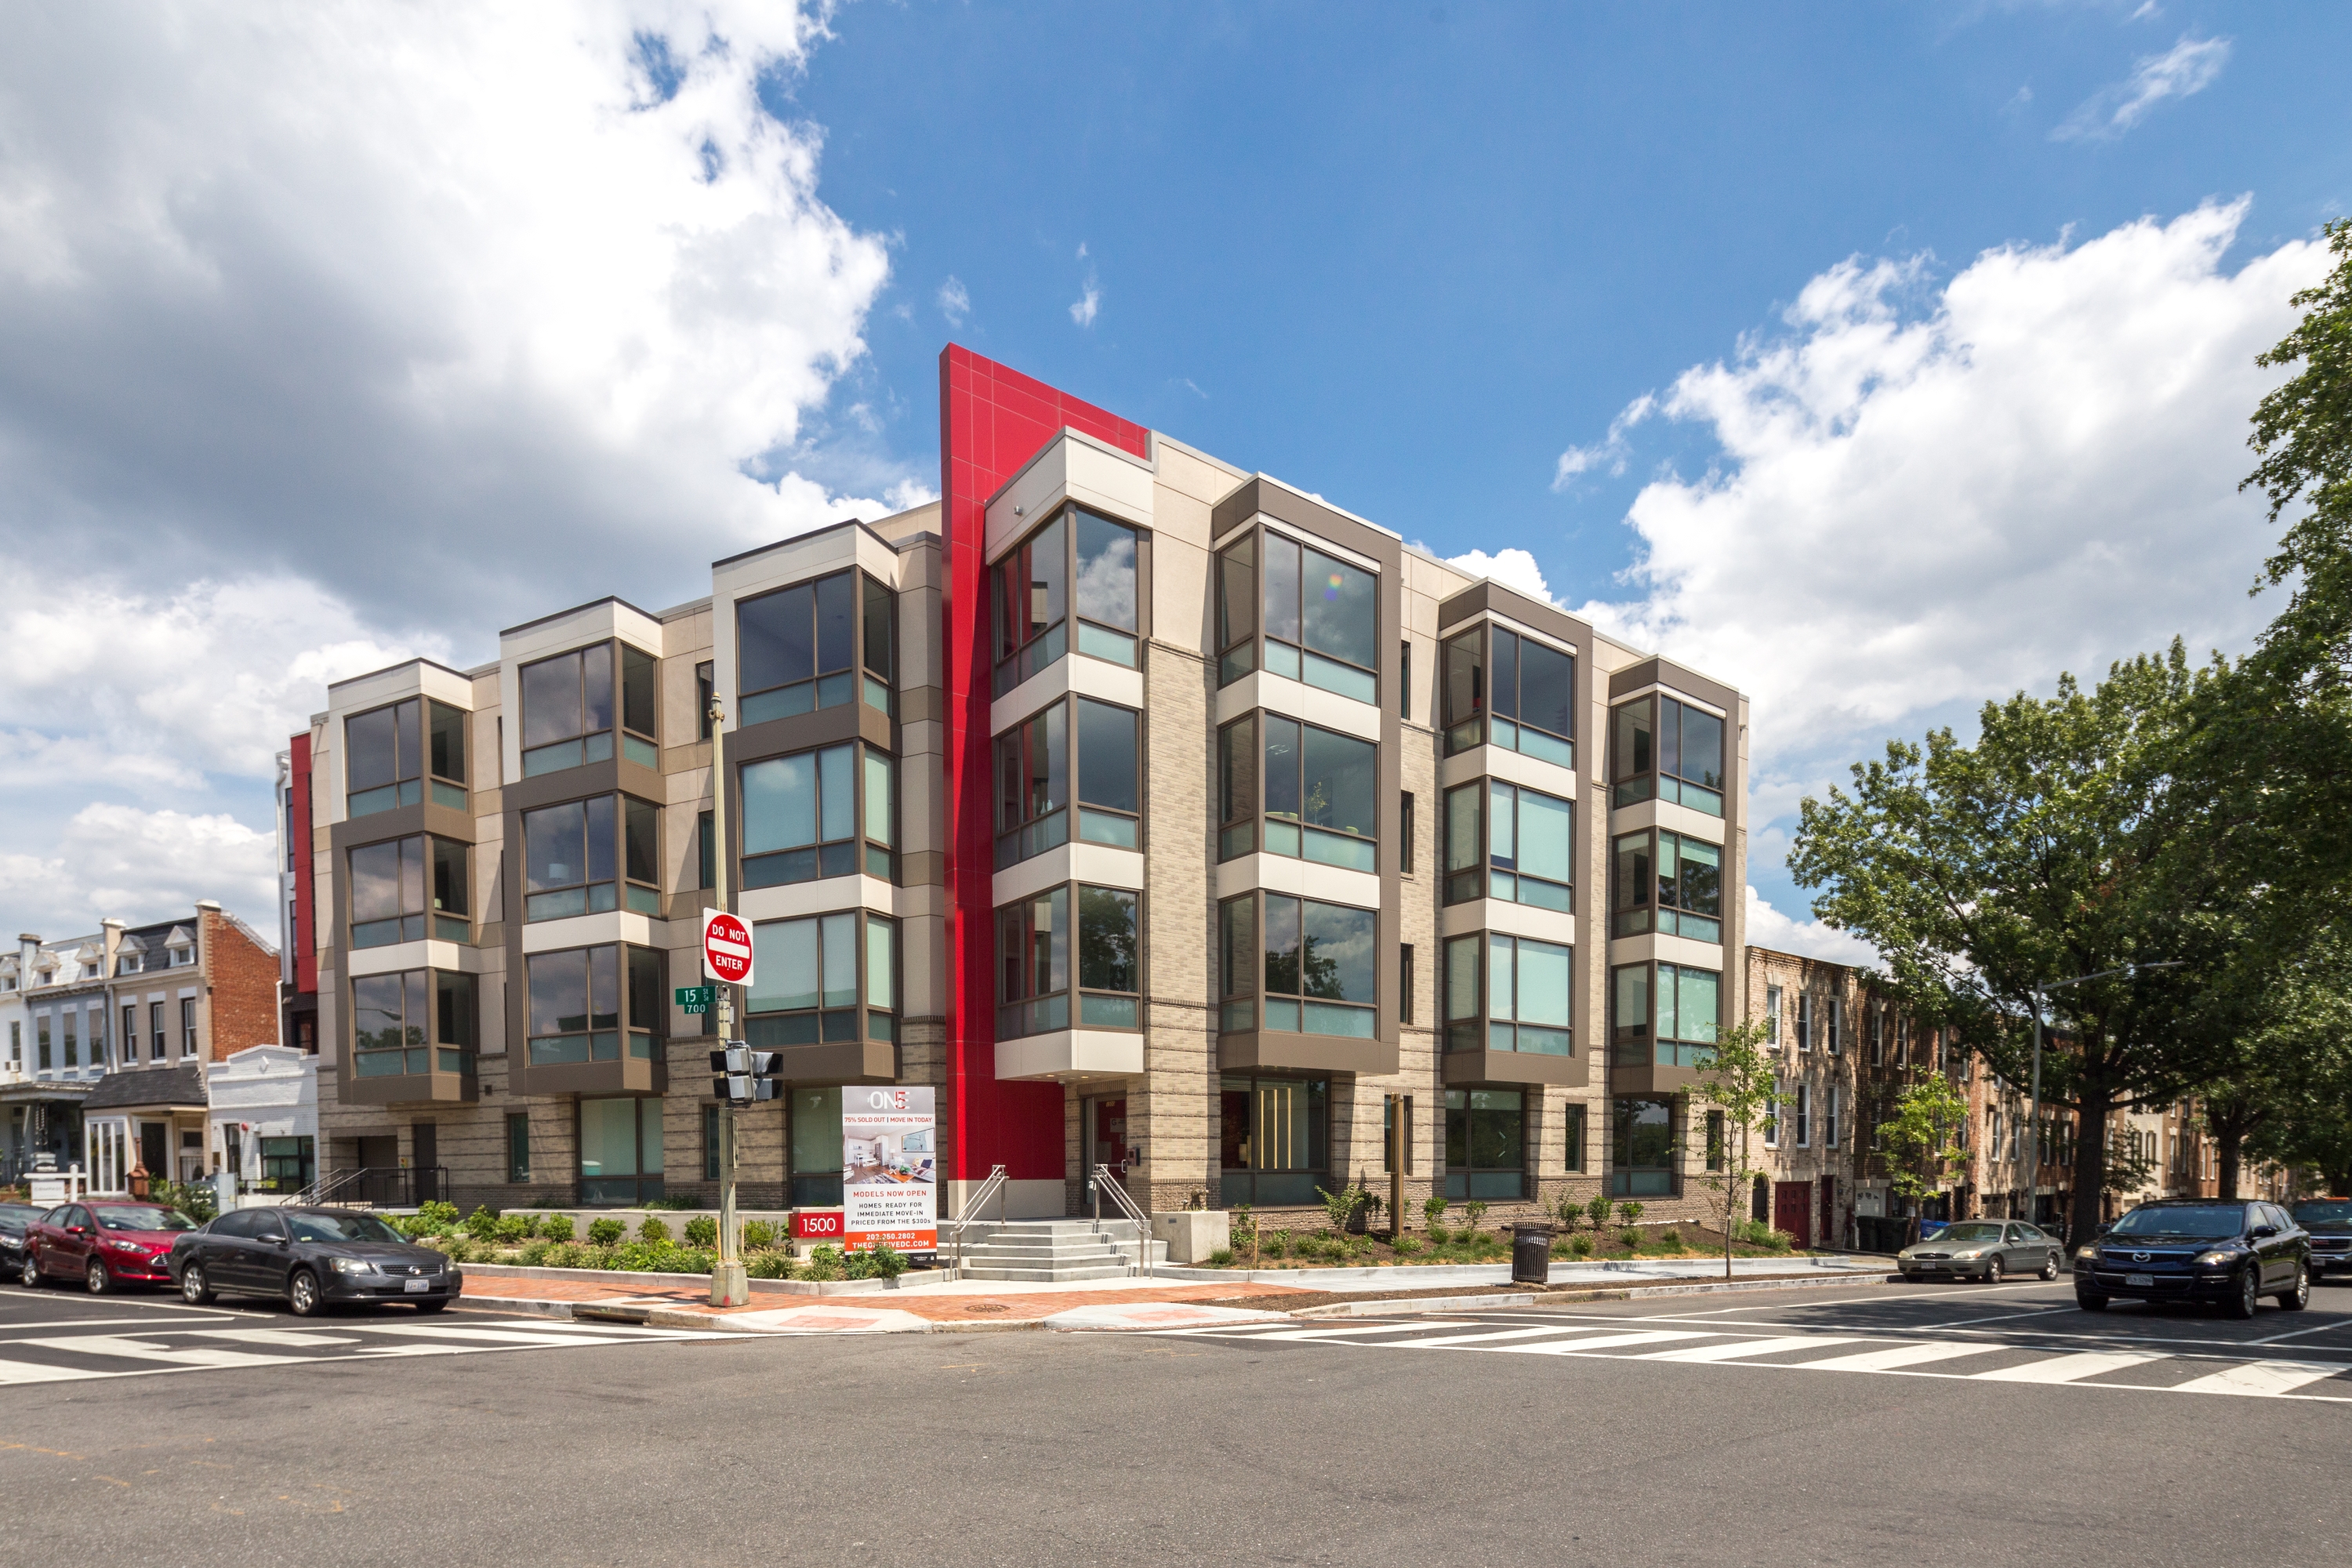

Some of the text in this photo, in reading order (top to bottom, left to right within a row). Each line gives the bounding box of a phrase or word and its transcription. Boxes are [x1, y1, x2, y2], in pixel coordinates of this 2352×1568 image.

[712, 924, 746, 942] DO NOT
[716, 955, 743, 971] ENTER
[684, 989, 696, 1003] 15
[687, 1004, 706, 1014] 700
[802, 1218, 836, 1232] 1500
